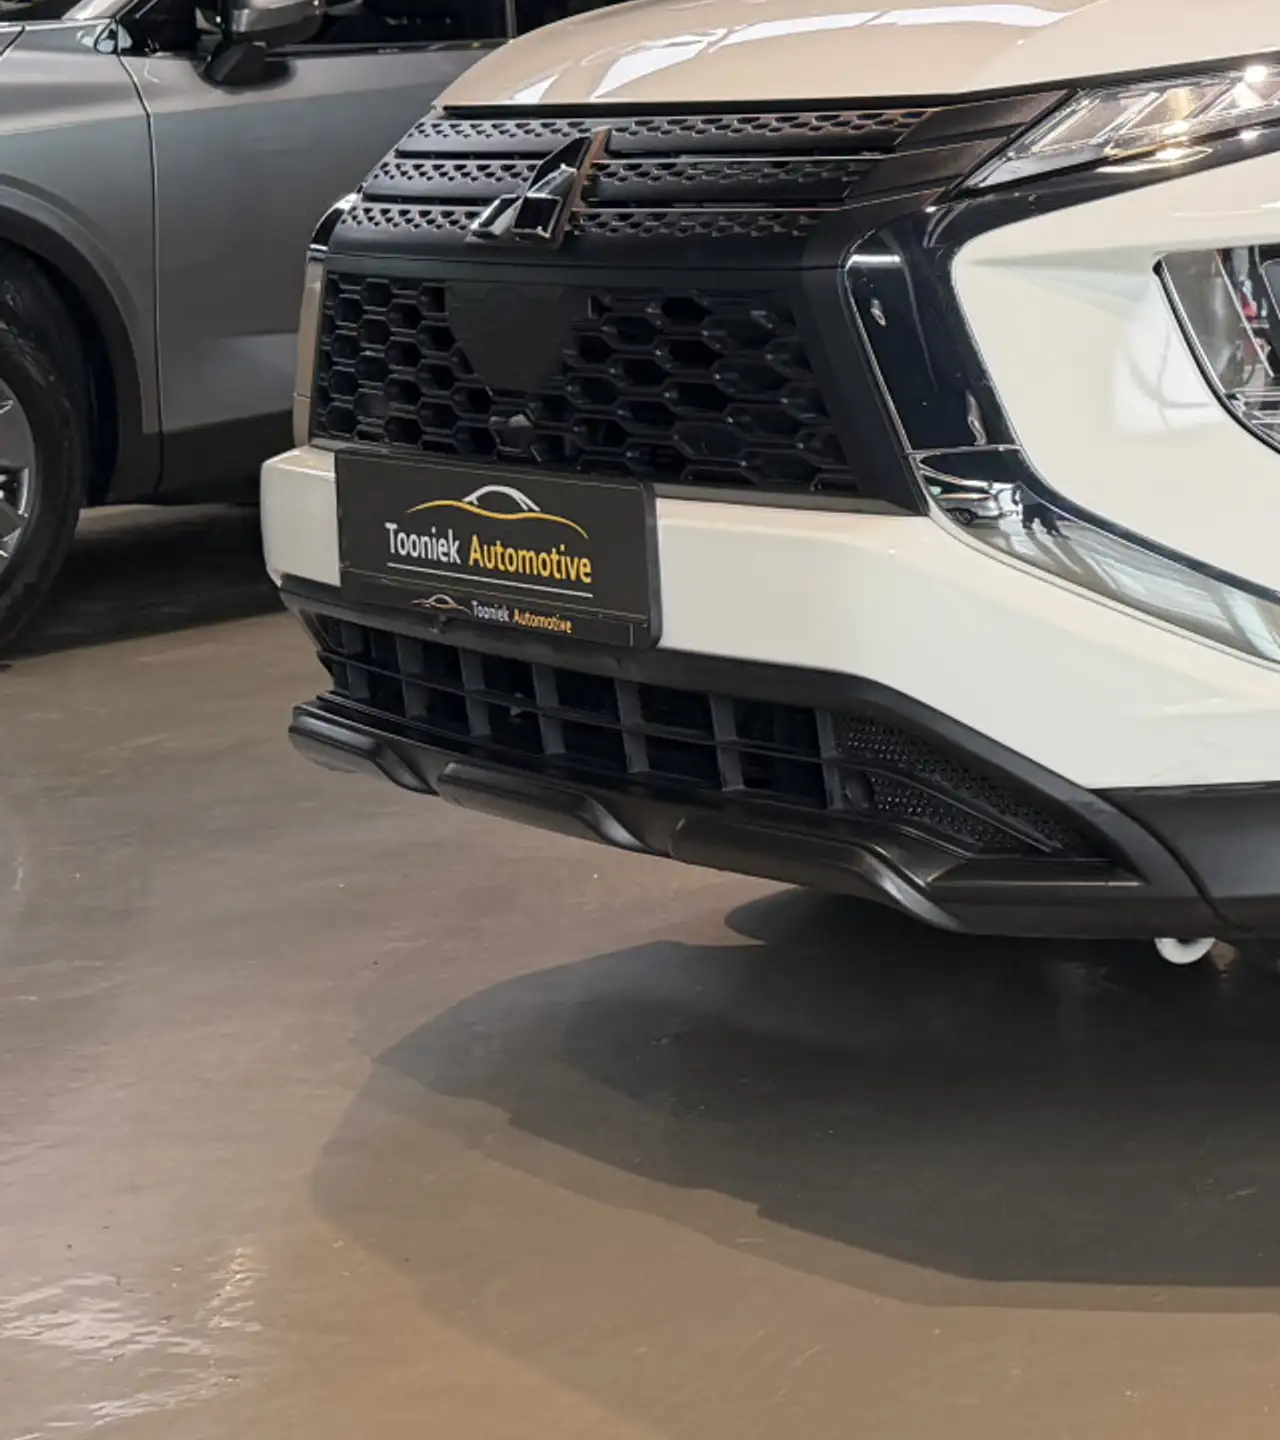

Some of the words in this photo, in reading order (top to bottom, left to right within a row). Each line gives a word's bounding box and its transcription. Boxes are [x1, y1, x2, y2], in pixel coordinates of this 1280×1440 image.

[385, 522, 461, 564] Tooniek
[468, 534, 592, 583] Automotive
[471, 600, 510, 622] Tooniek
[513, 608, 573, 633] Automotive
